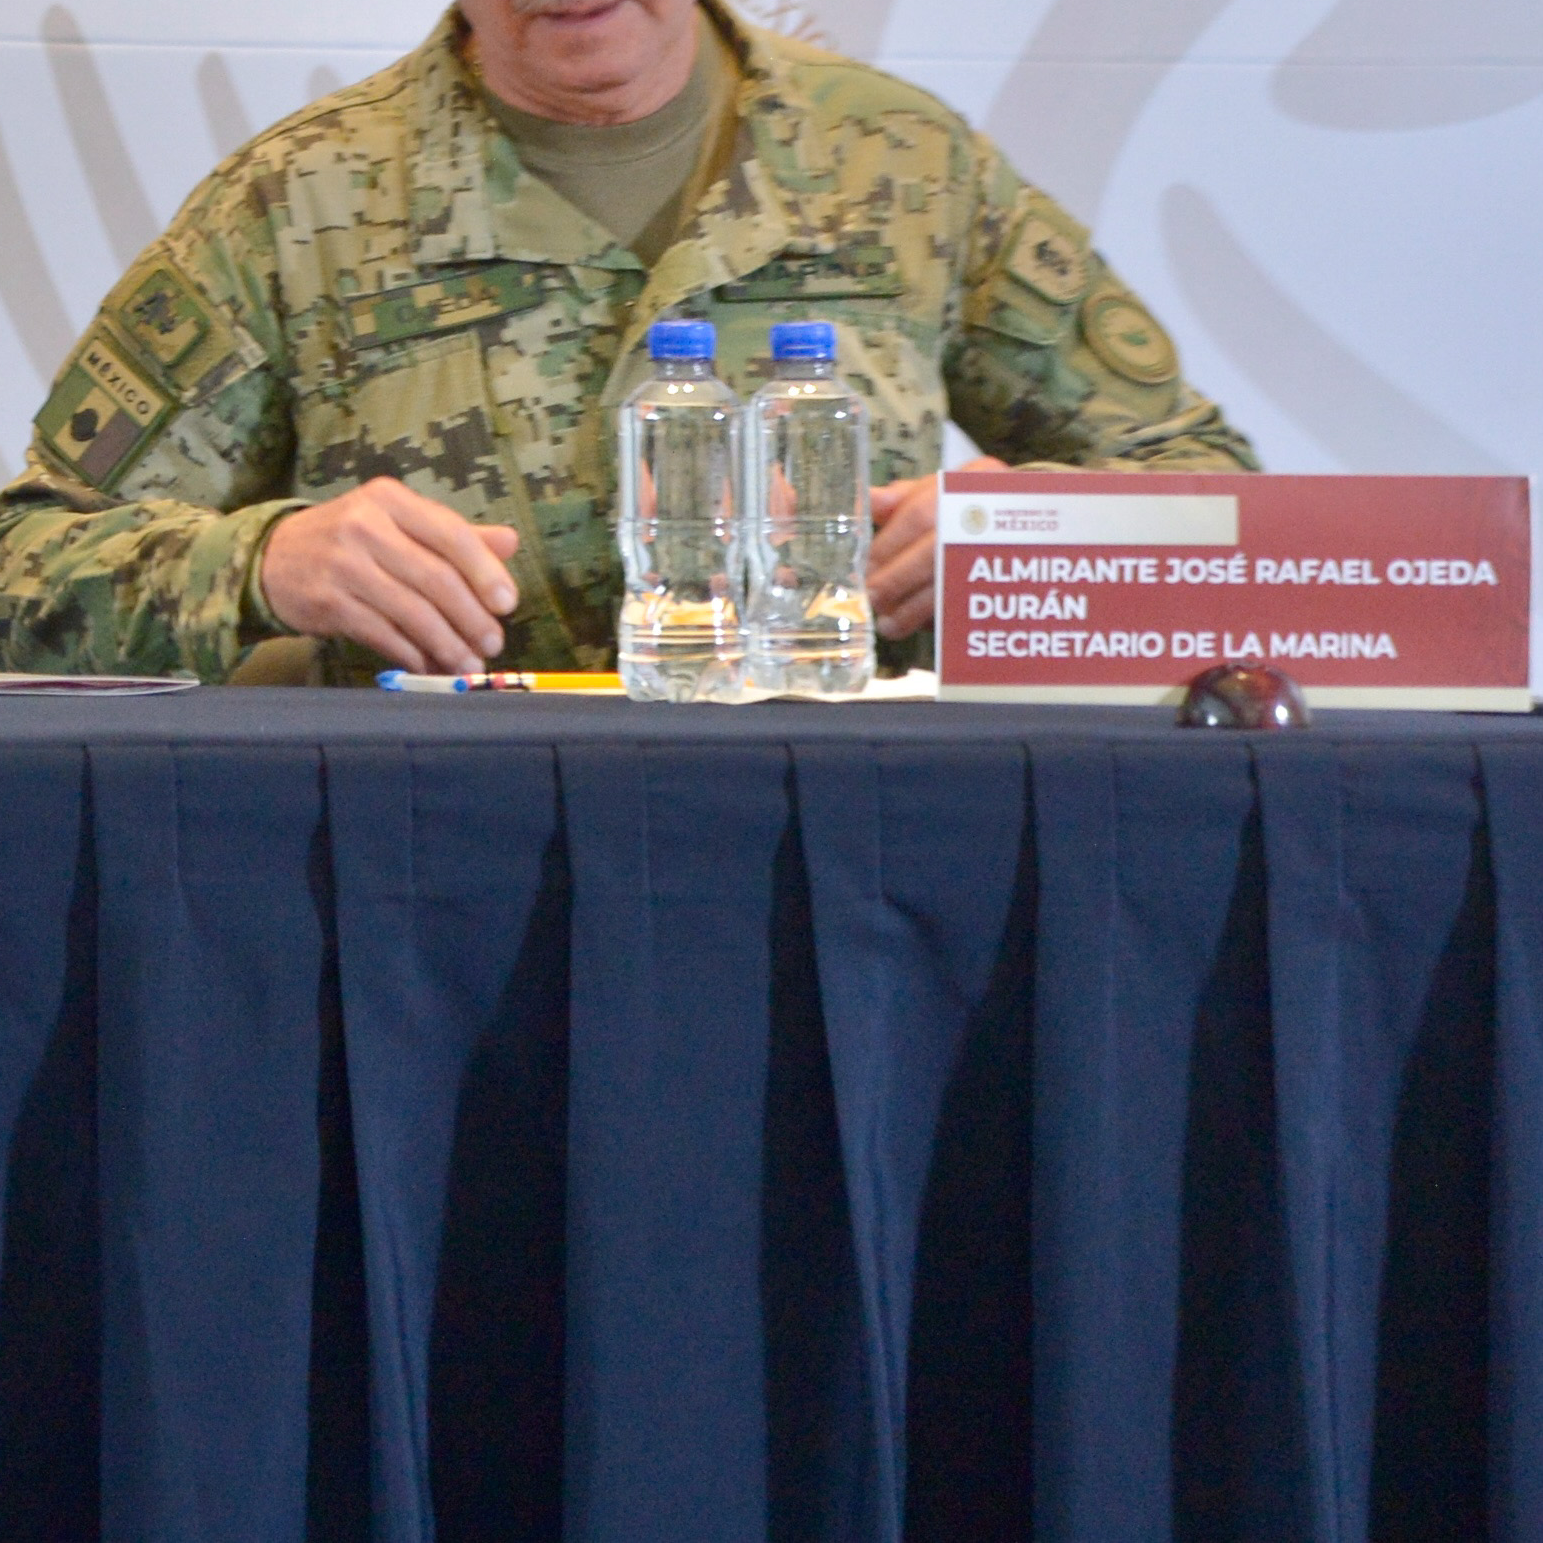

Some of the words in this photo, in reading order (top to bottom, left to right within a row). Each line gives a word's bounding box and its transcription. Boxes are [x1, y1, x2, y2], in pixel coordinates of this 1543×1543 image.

[86, 351, 151, 417] MÉXICO
[968, 556, 1159, 583] ALMIRANTE
[1164, 552, 1248, 585] JOSÉ
[1255, 558, 1382, 585] RAFAEL
[1386, 559, 1498, 586] OJEDA
[968, 589, 1088, 620] DURÁN
[967, 630, 1165, 658] SECRETARIO
[1171, 632, 1216, 658] DE
[1222, 632, 1264, 658] LA
[1269, 632, 1398, 659] MARINA
